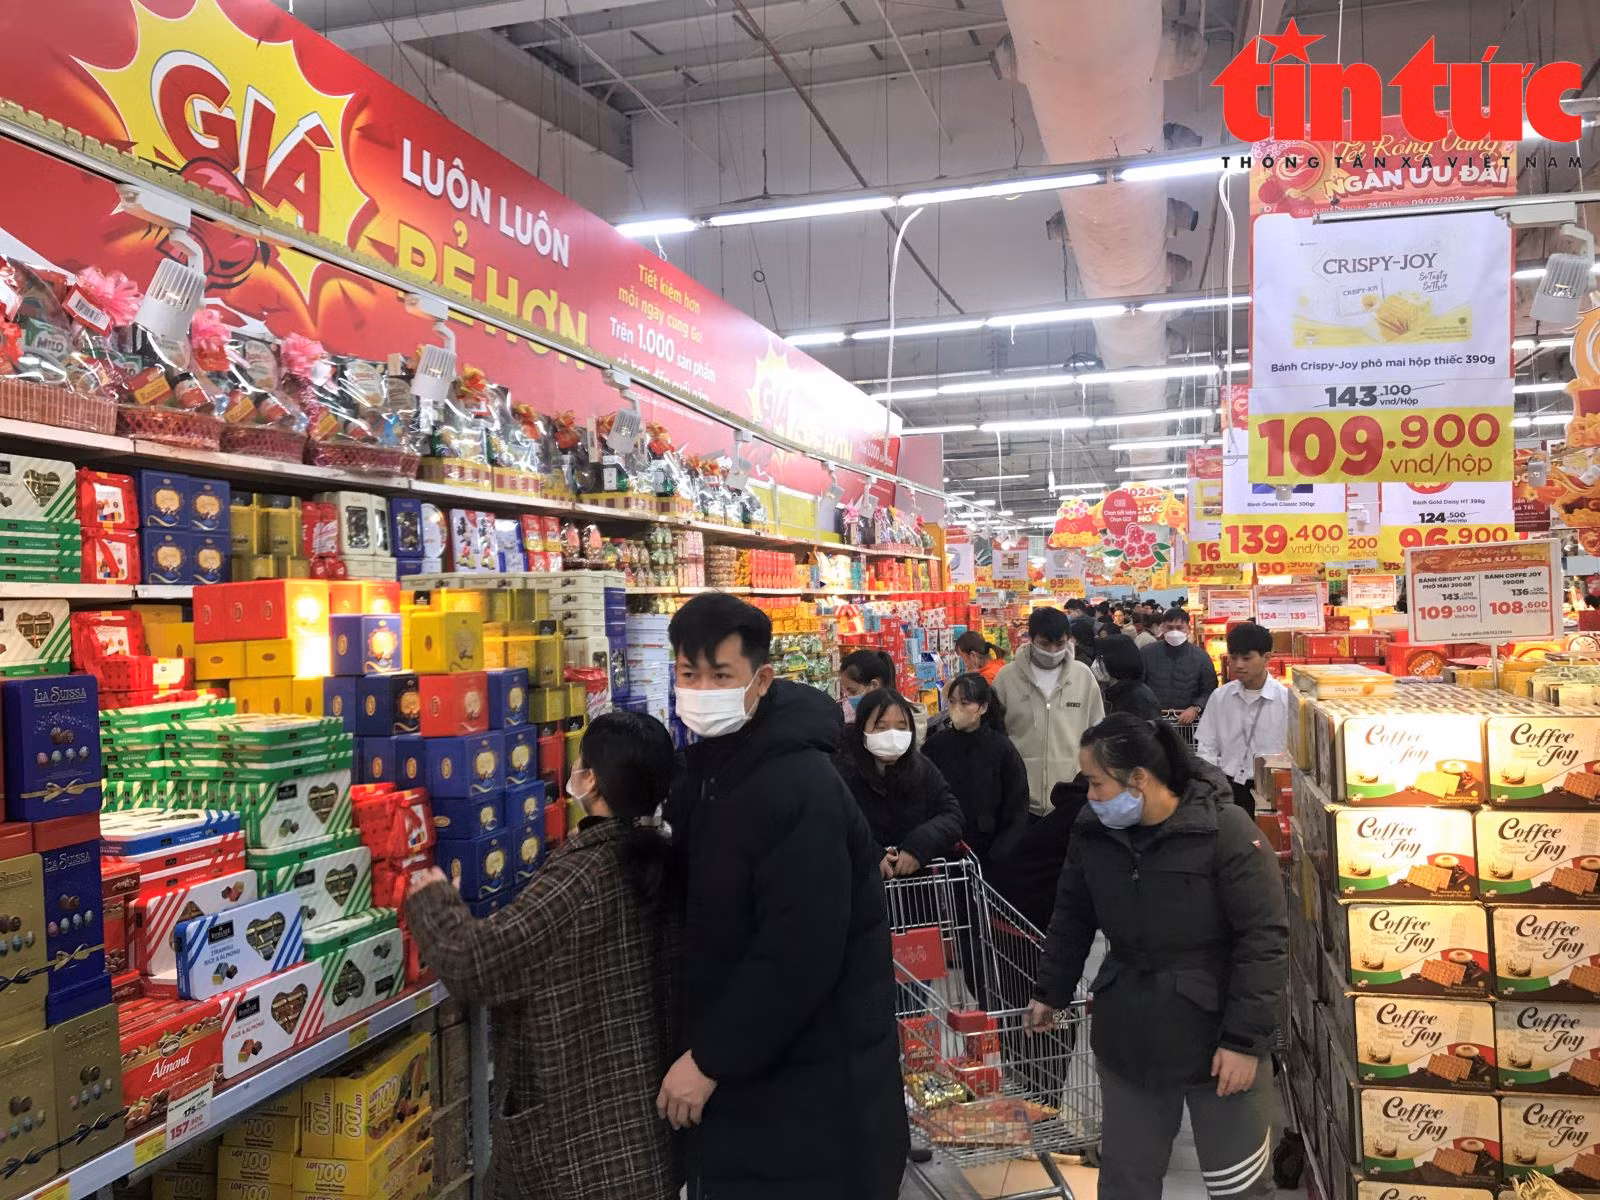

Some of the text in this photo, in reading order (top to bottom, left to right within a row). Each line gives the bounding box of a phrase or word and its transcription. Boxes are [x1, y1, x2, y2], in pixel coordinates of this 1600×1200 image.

[151, 50, 334, 233] GIÁ
[1324, 168, 1403, 195] NGÀN
[1409, 164, 1452, 185] ƯU
[402, 137, 569, 268] LUÔN LUÔN
[1368, 201, 1391, 209] 25/01
[1323, 252, 1438, 275] CRISPY-JOY
[638, 264, 659, 291] Tiết
[660, 277, 682, 304] kiệm
[618, 285, 639, 309] mỗi
[641, 299, 664, 325] ngày
[485, 265, 586, 370] HƠN
[36, 336, 64, 351] MILO
[610, 316, 634, 345] Trên
[637, 323, 675, 364] 1.000
[1271, 353, 1496, 373] Bánh Crispy-Joy phô mai hộp thiếc 390g
[1380, 398, 1419, 406] vnd/Hộp
[1390, 452, 1493, 476] vnd/hộp
[1413, 658, 1435, 675] Daisy
[34, 686, 87, 703] LA SUISSA
[1510, 722, 1573, 747] Coffee
[1537, 745, 1579, 767] Joy
[1357, 817, 1417, 840] Coffee
[1498, 817, 1561, 842] Coffee
[1382, 838, 1421, 859] Joy
[1525, 840, 1566, 861] Joy
[59, 852, 91, 869] SUISSA
[1369, 909, 1430, 934] Coffee
[1515, 914, 1579, 939] Coffee
[1395, 932, 1435, 953] Joy
[1542, 937, 1584, 959] Joy
[1376, 1002, 1437, 1027] Coffee
[1517, 1006, 1580, 1032] Coffee
[1402, 1025, 1442, 1047] Joy
[1544, 1030, 1584, 1052] Joy
[148, 1046, 194, 1082] Almond
[312, 1103, 332, 1136] 100
[1382, 1096, 1443, 1121] Coffee
[1522, 1102, 1584, 1128] Coffee
[245, 1118, 276, 1139] 100
[344, 1103, 362, 1138] 100
[1408, 1119, 1447, 1141] Joy
[1549, 1126, 1589, 1147] Joy
[241, 1151, 272, 1172] 100
[305, 1161, 347, 1184] LOT 100
